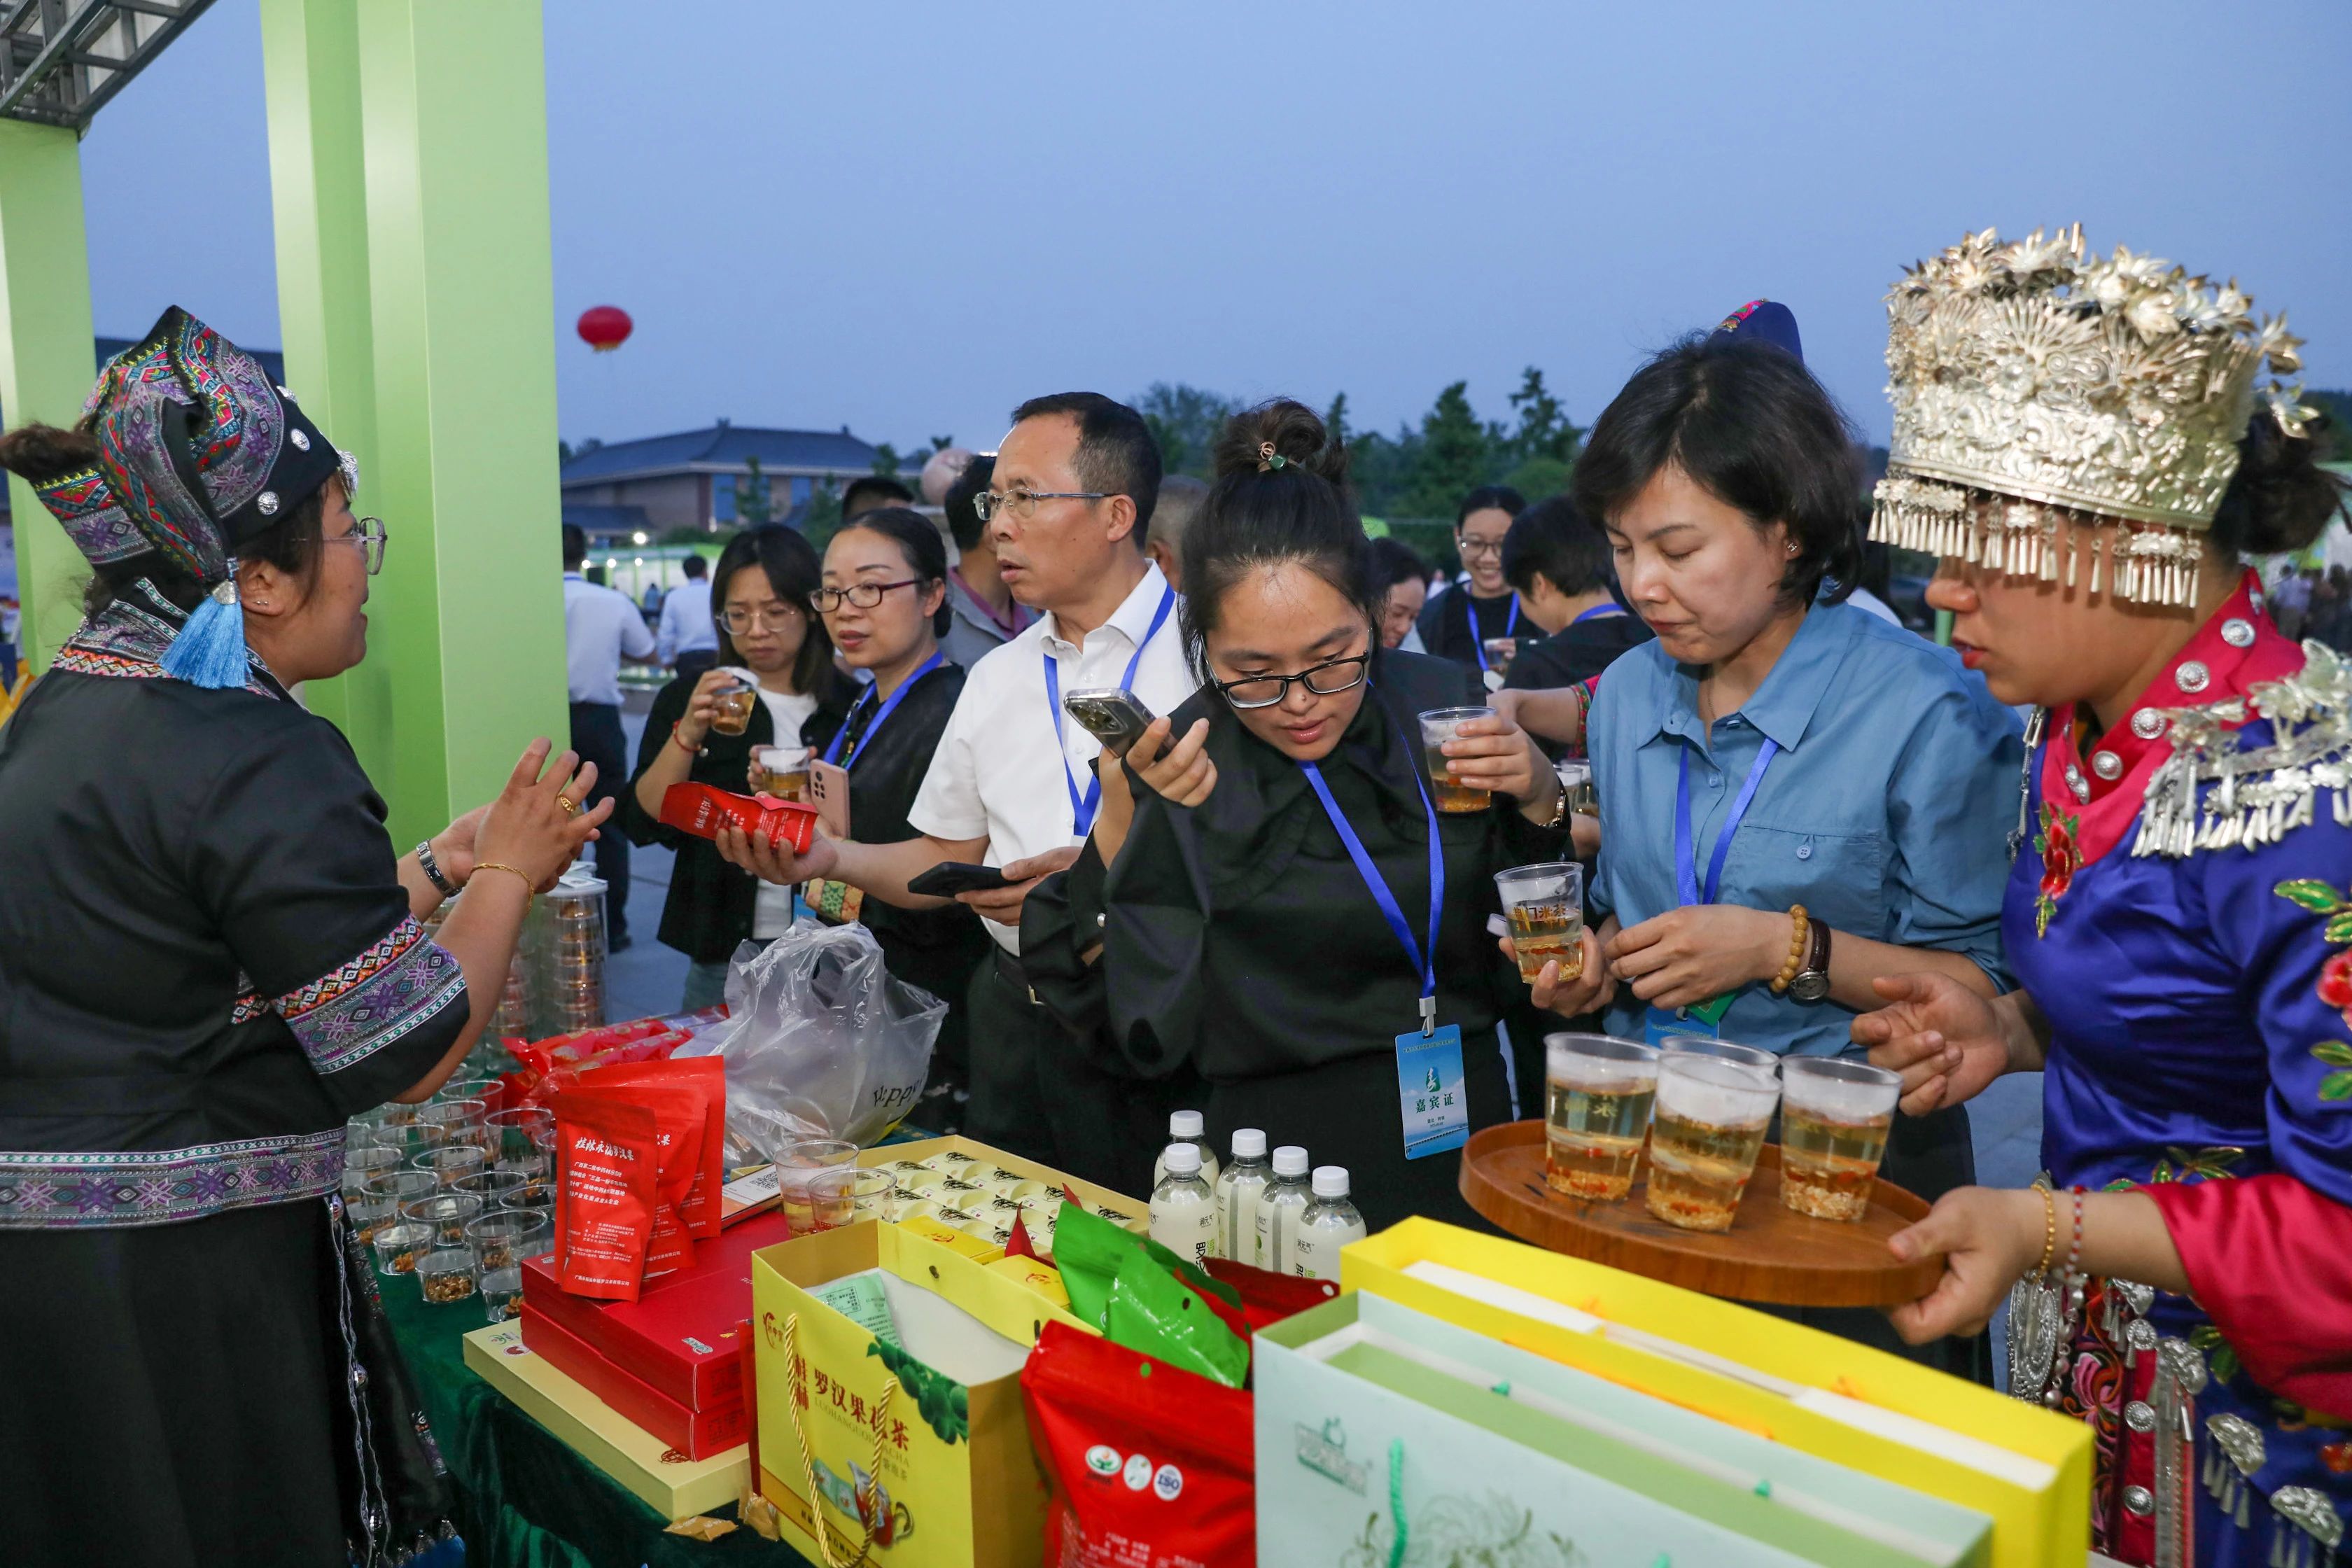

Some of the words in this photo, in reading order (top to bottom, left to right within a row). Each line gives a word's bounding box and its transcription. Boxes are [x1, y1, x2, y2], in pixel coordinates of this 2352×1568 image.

[1415, 1091, 1455, 1114] 嘉宾证
[1199, 1214, 1213, 1226] 润元气
[794, 1353, 809, 1411] 桂林
[1157, 1473, 1180, 1491] ISO
